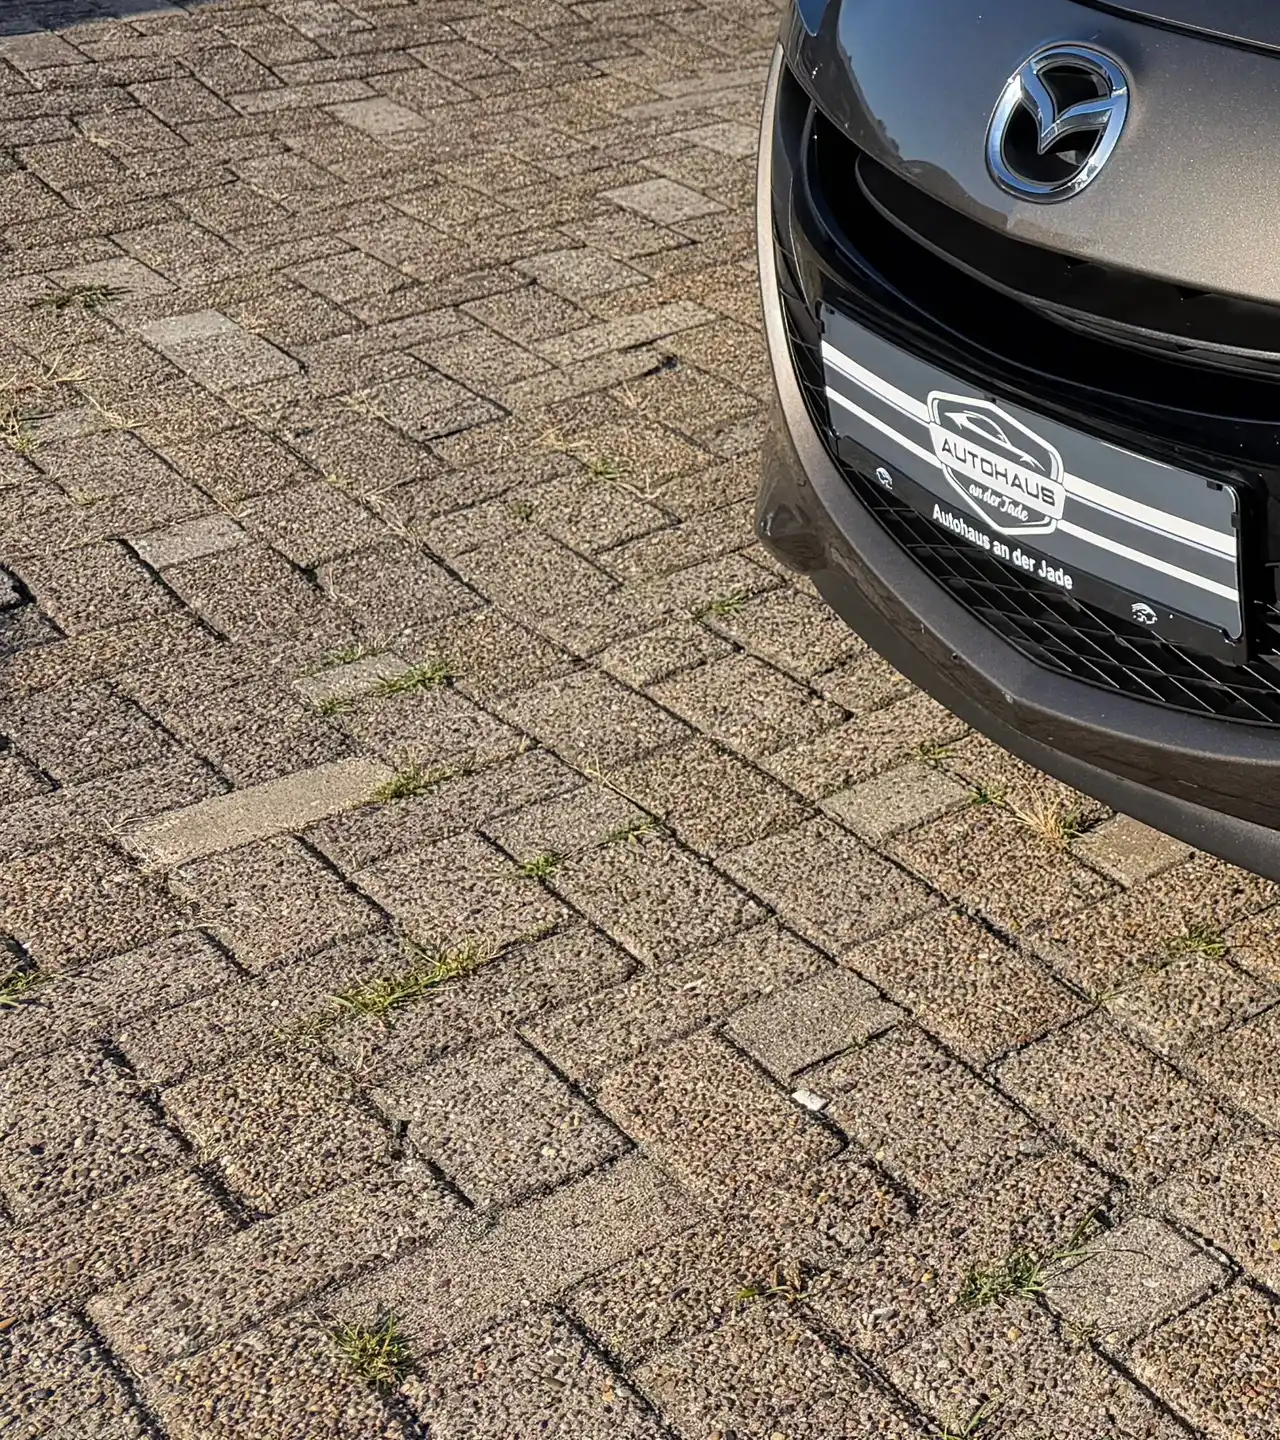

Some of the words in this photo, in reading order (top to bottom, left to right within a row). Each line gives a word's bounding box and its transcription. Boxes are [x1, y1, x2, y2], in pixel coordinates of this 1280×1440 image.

[941, 438, 1056, 507] AUTOHAUS
[968, 483, 984, 501] an
[983, 486, 1001, 509] der
[999, 495, 1030, 522] Jade
[932, 503, 991, 551] Autohaus
[992, 540, 1010, 561] an
[1012, 547, 1035, 573] der
[1037, 559, 1074, 590] Jade
